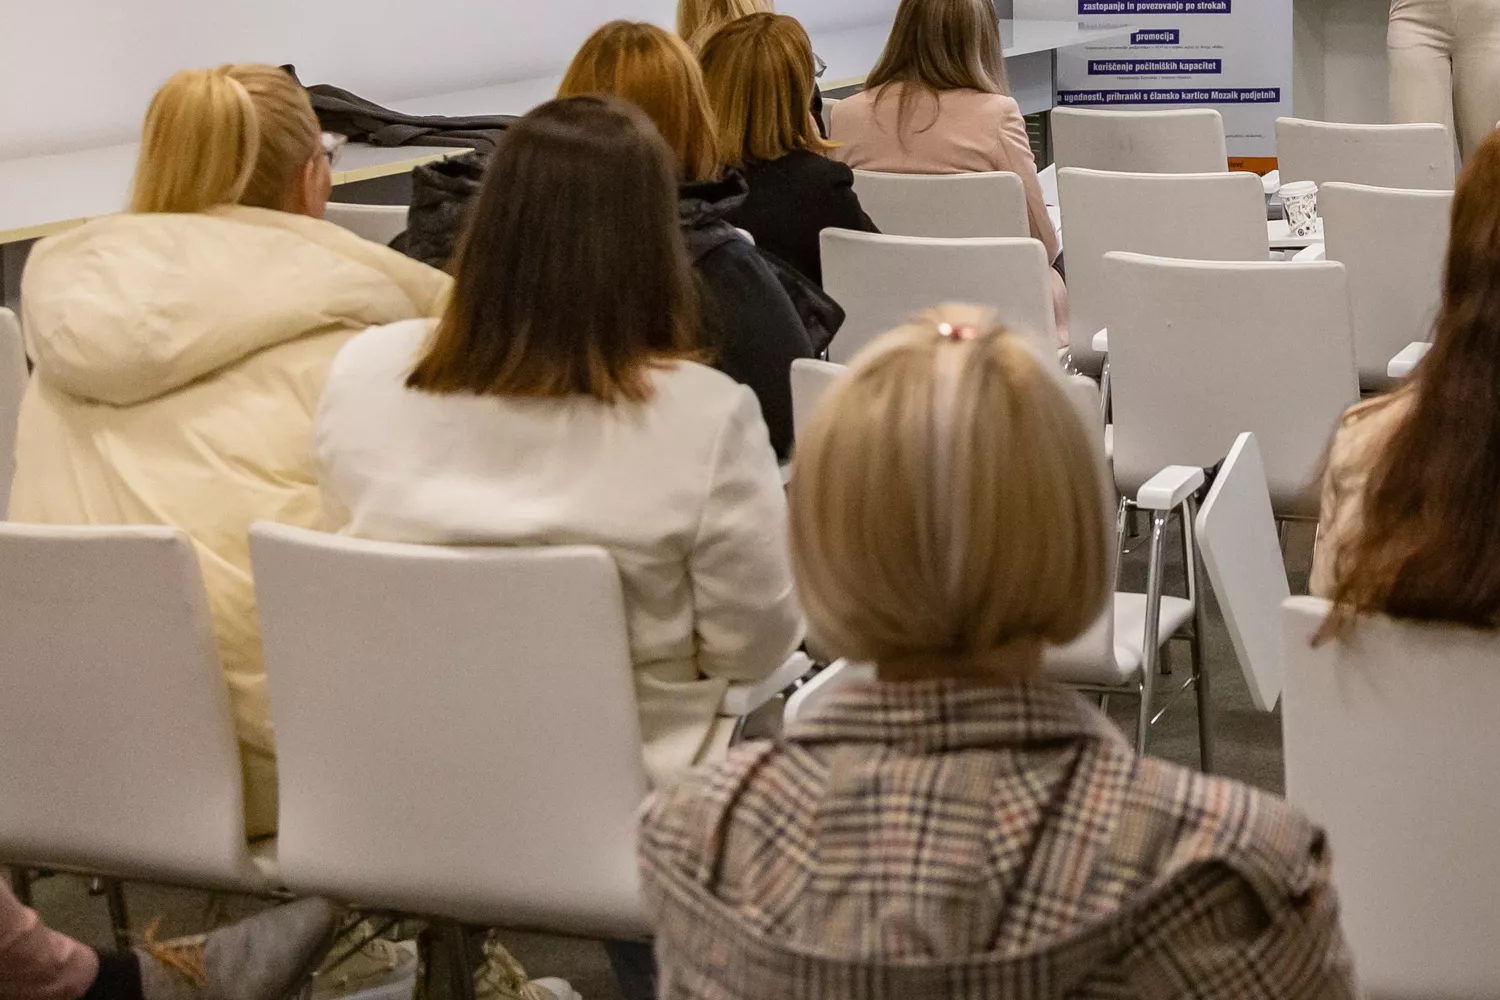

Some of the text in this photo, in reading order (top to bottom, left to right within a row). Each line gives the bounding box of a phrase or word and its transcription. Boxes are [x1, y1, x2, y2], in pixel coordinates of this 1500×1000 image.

[1083, 1, 1226, 11] zastopanje in povezovanje po strokah
[1136, 32, 1174, 41] promocija
[1093, 61, 1216, 71] koriščenje počitniških kapacitet
[1064, 92, 1104, 102] ugodnosti,
[1106, 92, 1141, 103] prihranki
[1150, 92, 1179, 100] člansko
[1182, 91, 1209, 100] kartico
[1211, 91, 1238, 100] Mozaik
[1240, 90, 1276, 100] podjetnih
